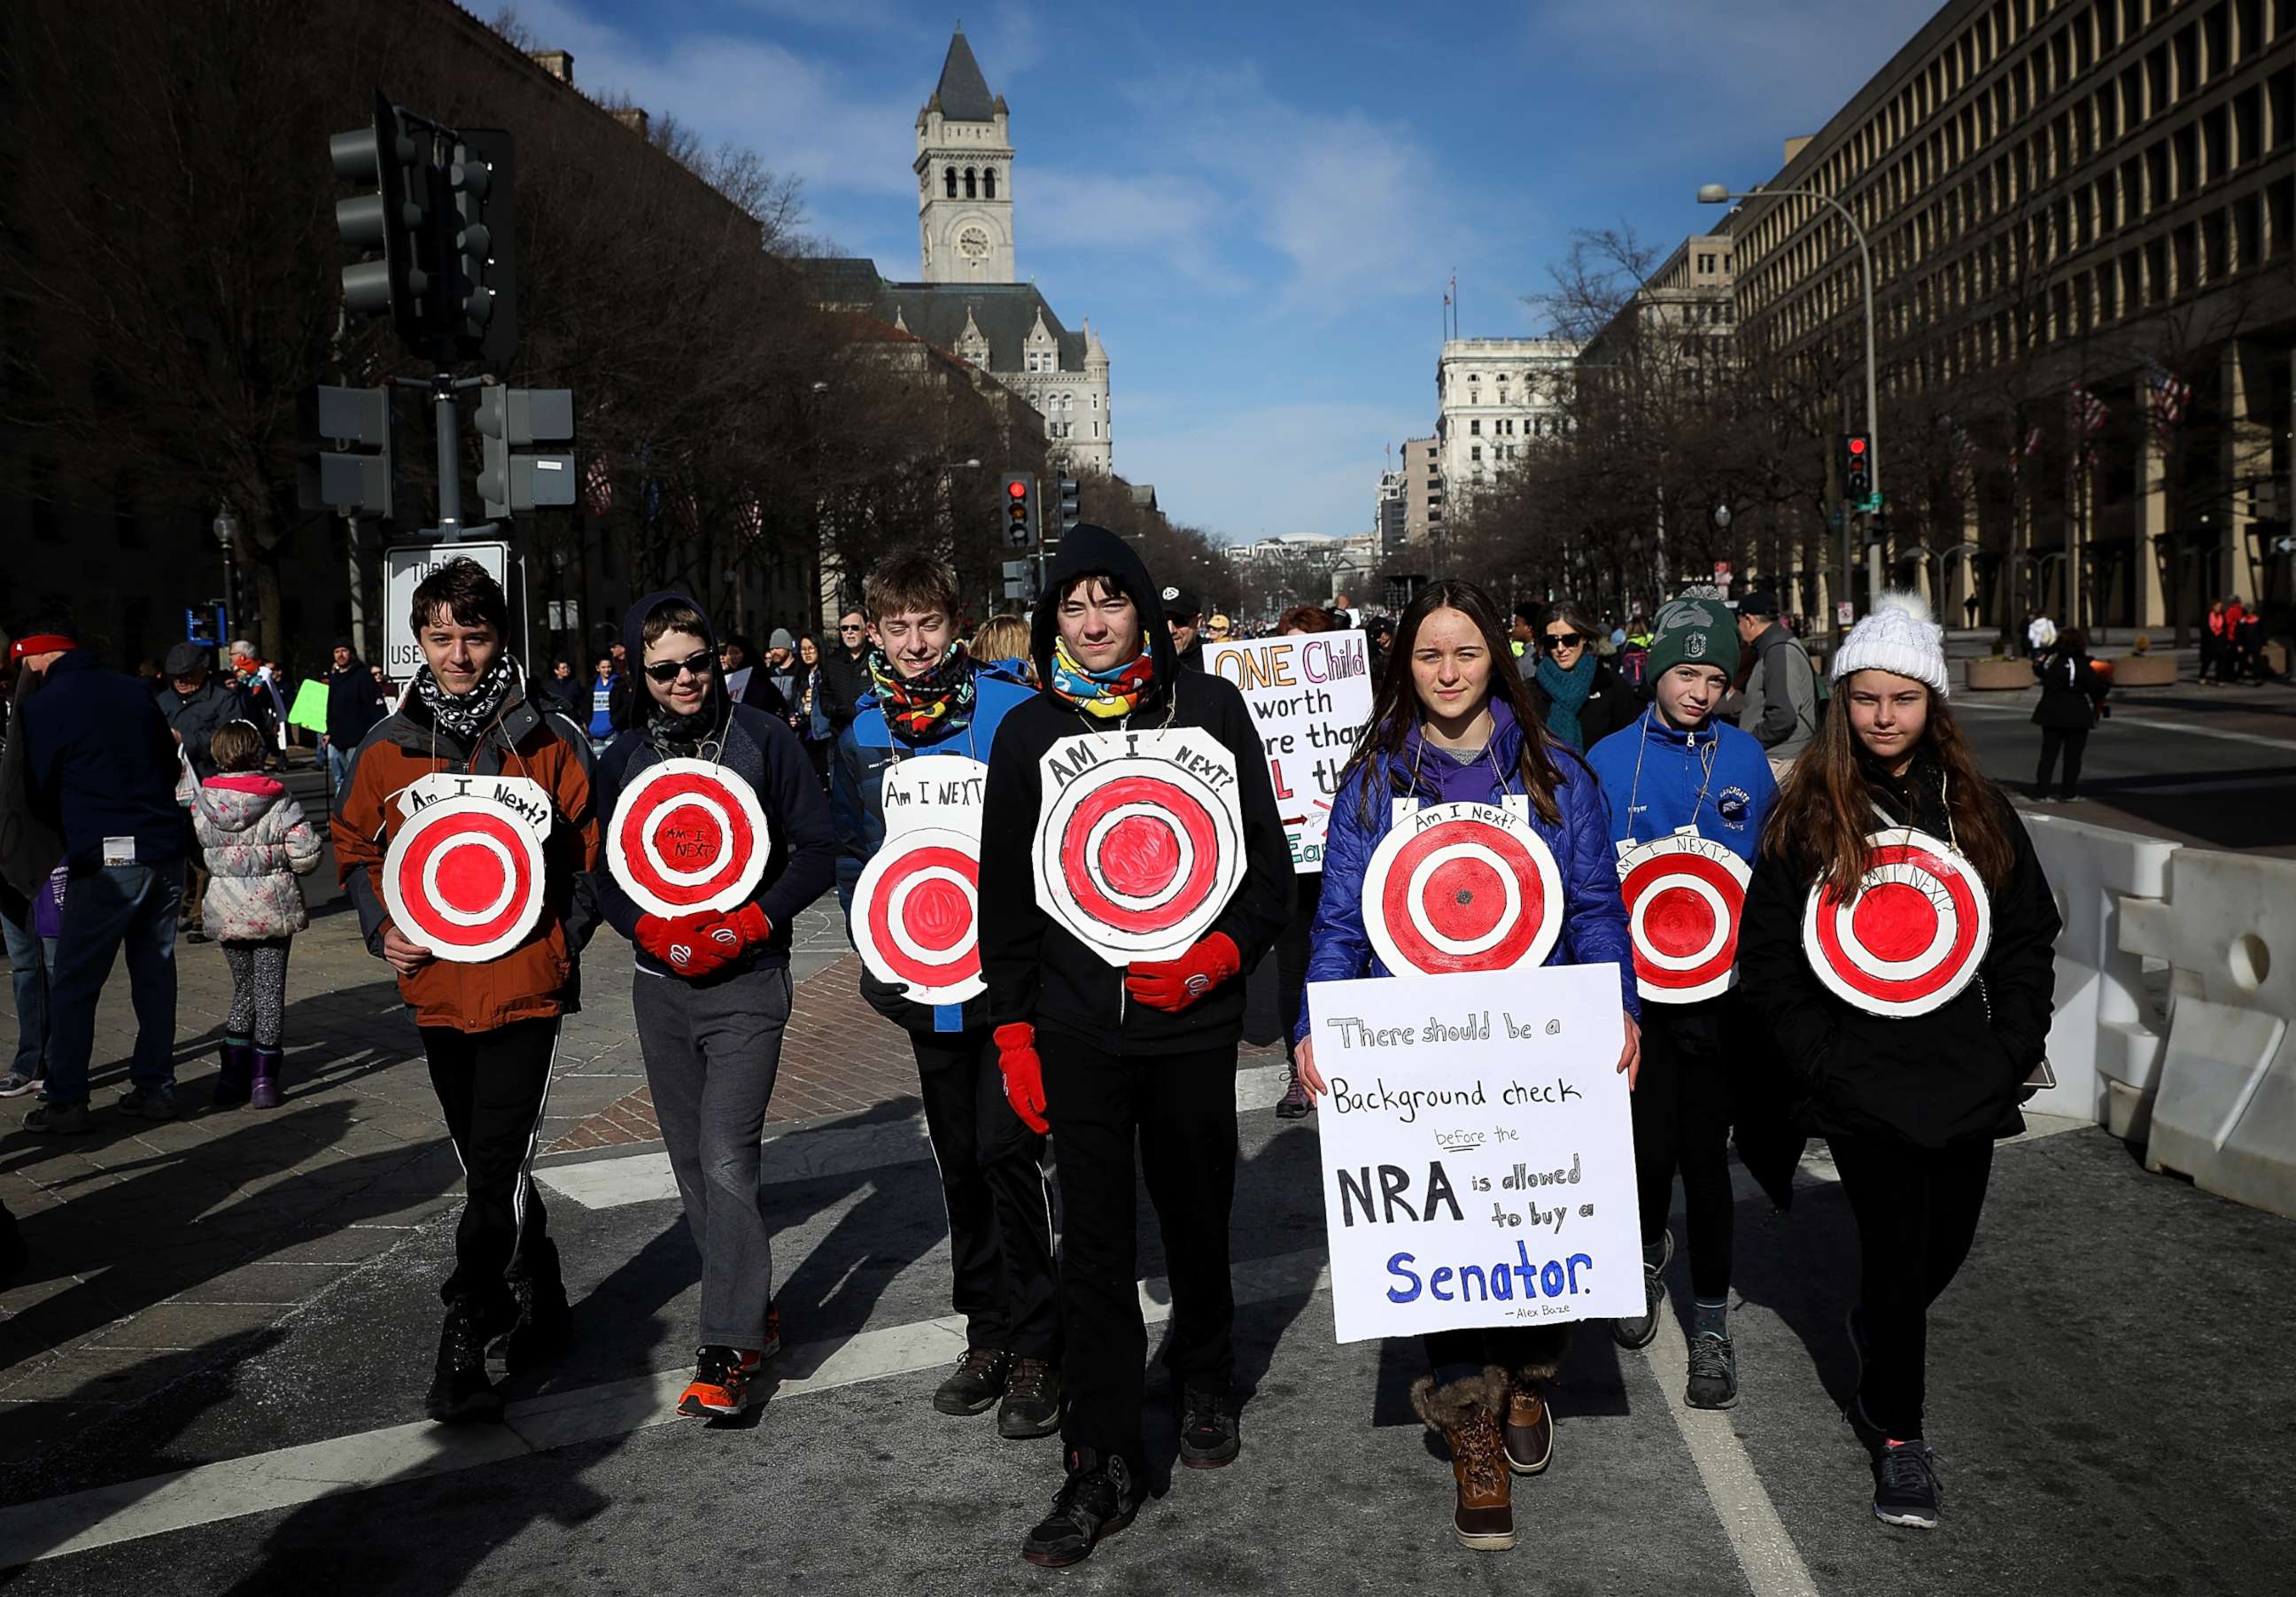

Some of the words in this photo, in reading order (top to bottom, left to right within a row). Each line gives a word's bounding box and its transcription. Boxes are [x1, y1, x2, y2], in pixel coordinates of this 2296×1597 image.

[391, 645, 423, 664] USE
[1214, 644, 1297, 692] ONE
[1302, 639, 1367, 684] Child
[1253, 688, 1333, 719] worth
[1048, 739, 1098, 788] AM
[1126, 733, 1139, 757] I
[1175, 745, 1235, 793] NEXT?
[410, 789, 438, 812] Am
[454, 779, 473, 796] I
[493, 783, 547, 829] Next?
[884, 781, 911, 808] Am
[918, 781, 930, 804] I
[938, 778, 983, 806] NEXT
[1415, 812, 1442, 833] Am
[1449, 803, 1462, 819] I
[1470, 805, 1516, 830] Next?
[666, 827, 686, 840] AM
[694, 830, 704, 842] I
[1287, 833, 1329, 863] Ea
[1646, 842, 1661, 857] I
[1676, 837, 1731, 863] NEXT?
[1327, 1017, 1415, 1049] There
[1422, 1011, 1490, 1043] should
[1503, 1012, 1532, 1039] be
[1545, 1019, 1561, 1035] a
[1330, 1077, 1486, 1123] Background
[1502, 1078, 1582, 1105] check
[1434, 1128, 1487, 1146] before
[1493, 1125, 1520, 1143] the
[1337, 1160, 1464, 1228] NRA
[1471, 1175, 1492, 1192] is
[1501, 1152, 1581, 1191] allowed
[1491, 1202, 1522, 1228] to
[1529, 1201, 1567, 1235] buy
[1578, 1203, 1594, 1217] a
[1386, 1239, 1594, 1304] Senator.
[1541, 1303, 1571, 1315] Baze
